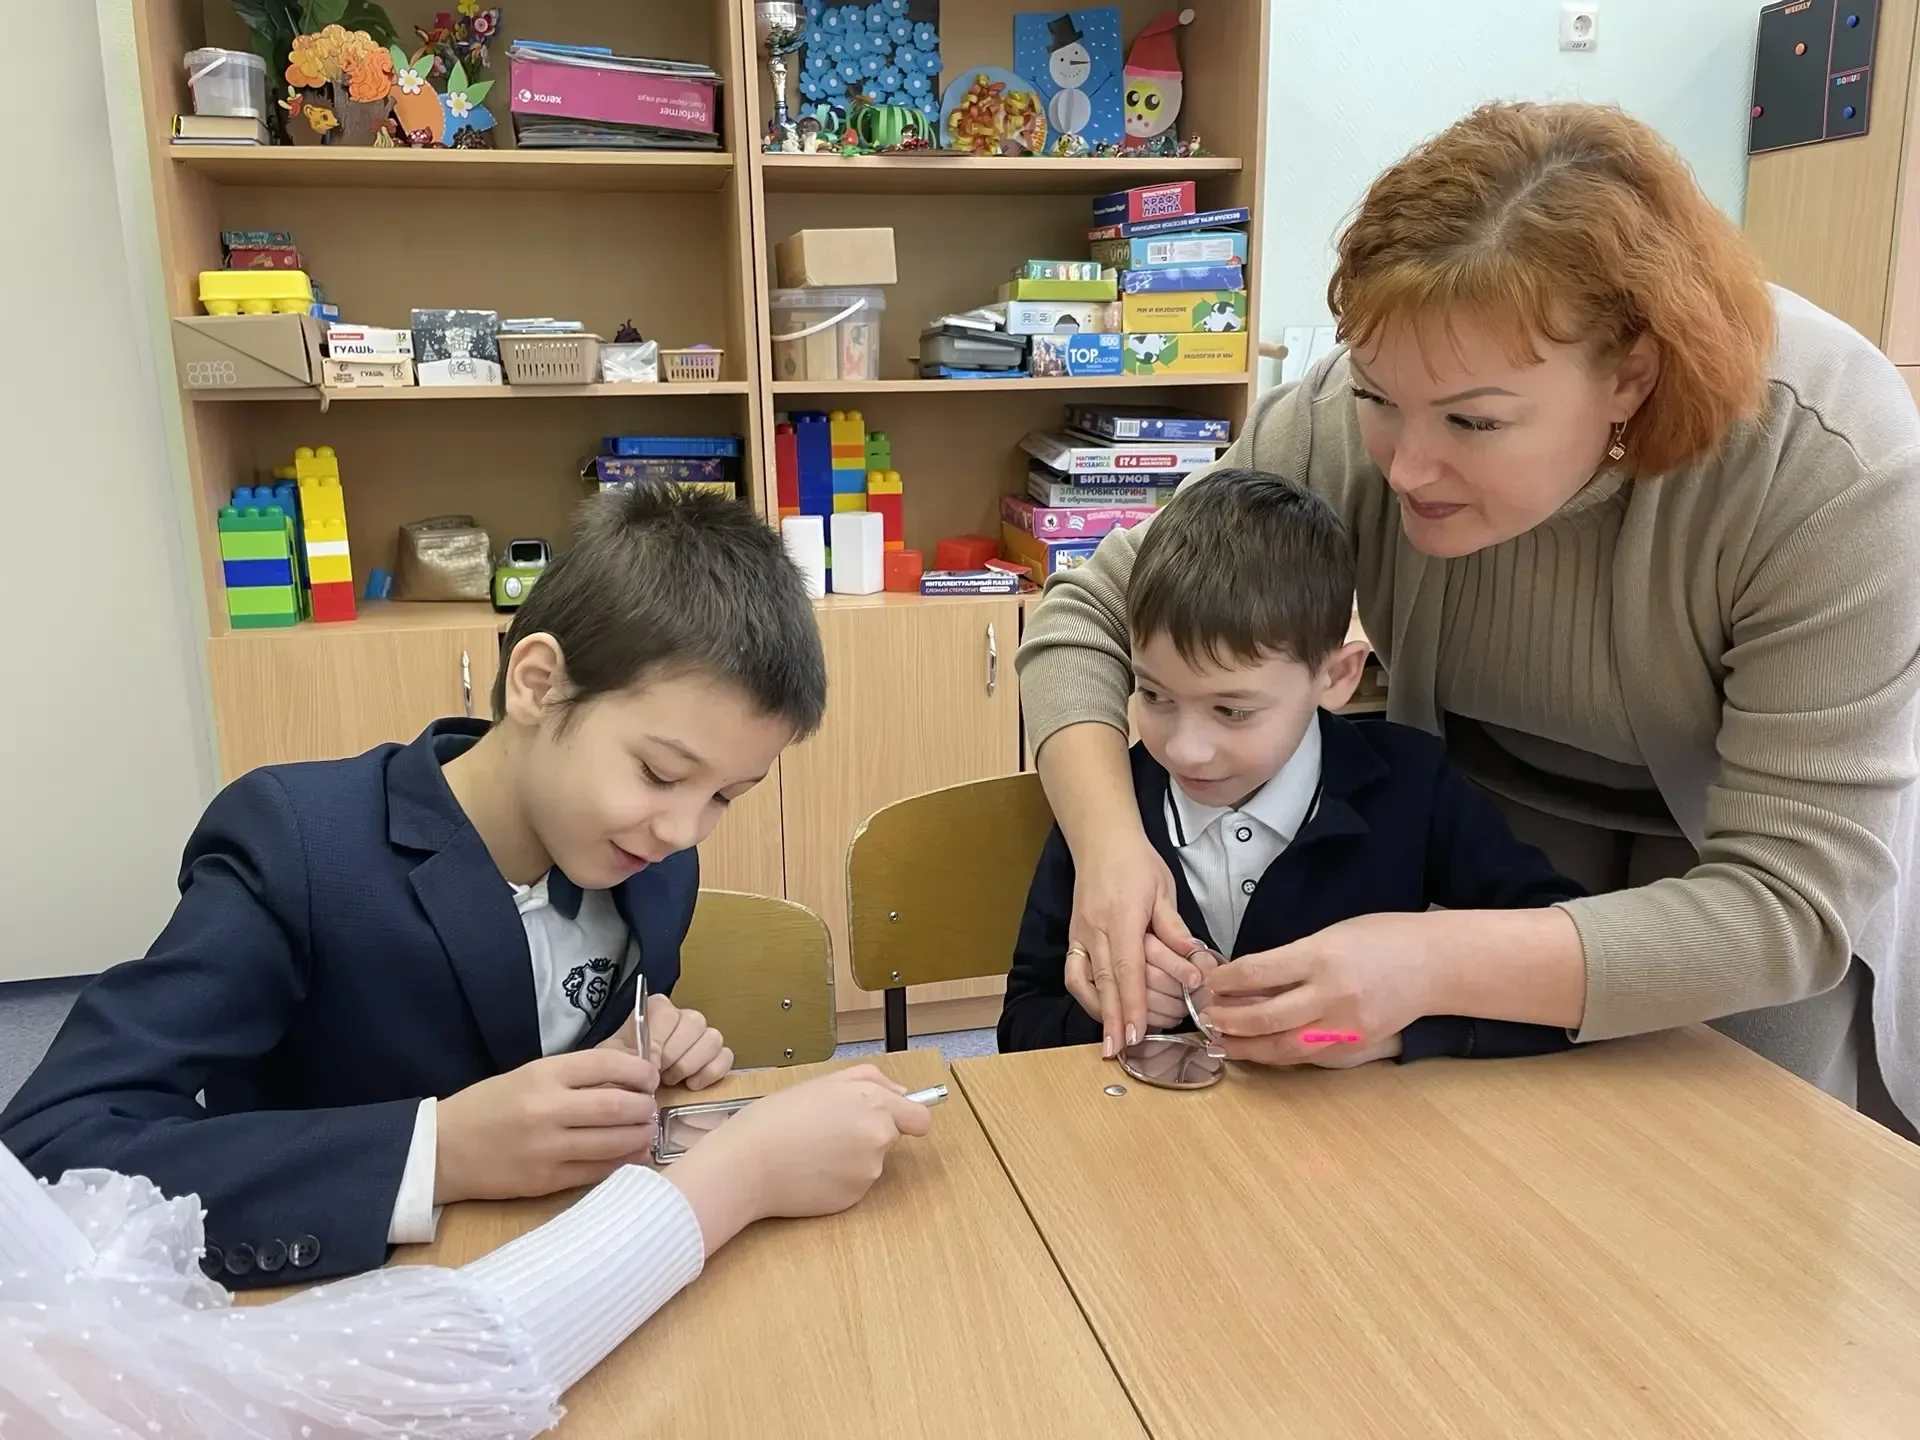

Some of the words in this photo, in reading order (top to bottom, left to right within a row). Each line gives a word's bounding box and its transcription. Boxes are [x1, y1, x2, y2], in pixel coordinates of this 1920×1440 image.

[1784, 0, 1811, 15] WEEKLY
[1836, 73, 1860, 86] BONUS
[534, 93, 562, 104] xerox
[659, 107, 706, 122] Performer
[1143, 194, 1180, 207] КРАФТ
[1143, 204, 1181, 216] ЛАМПА
[397, 332, 407, 340] 12
[334, 345, 374, 354] ГУАШЬ
[1069, 348, 1099, 364] TOP
[1094, 355, 1120, 365] puzzle
[1119, 457, 1137, 466] 174
[1080, 475, 1117, 484] БИТВА
[1118, 474, 1150, 484] УМОВ
[1059, 487, 1147, 496] ЭЛЕКТРОВИКТОРИНА
[925, 579, 992, 587] ИНТЕЛЛЕКТУАЛЬНЫЙ
